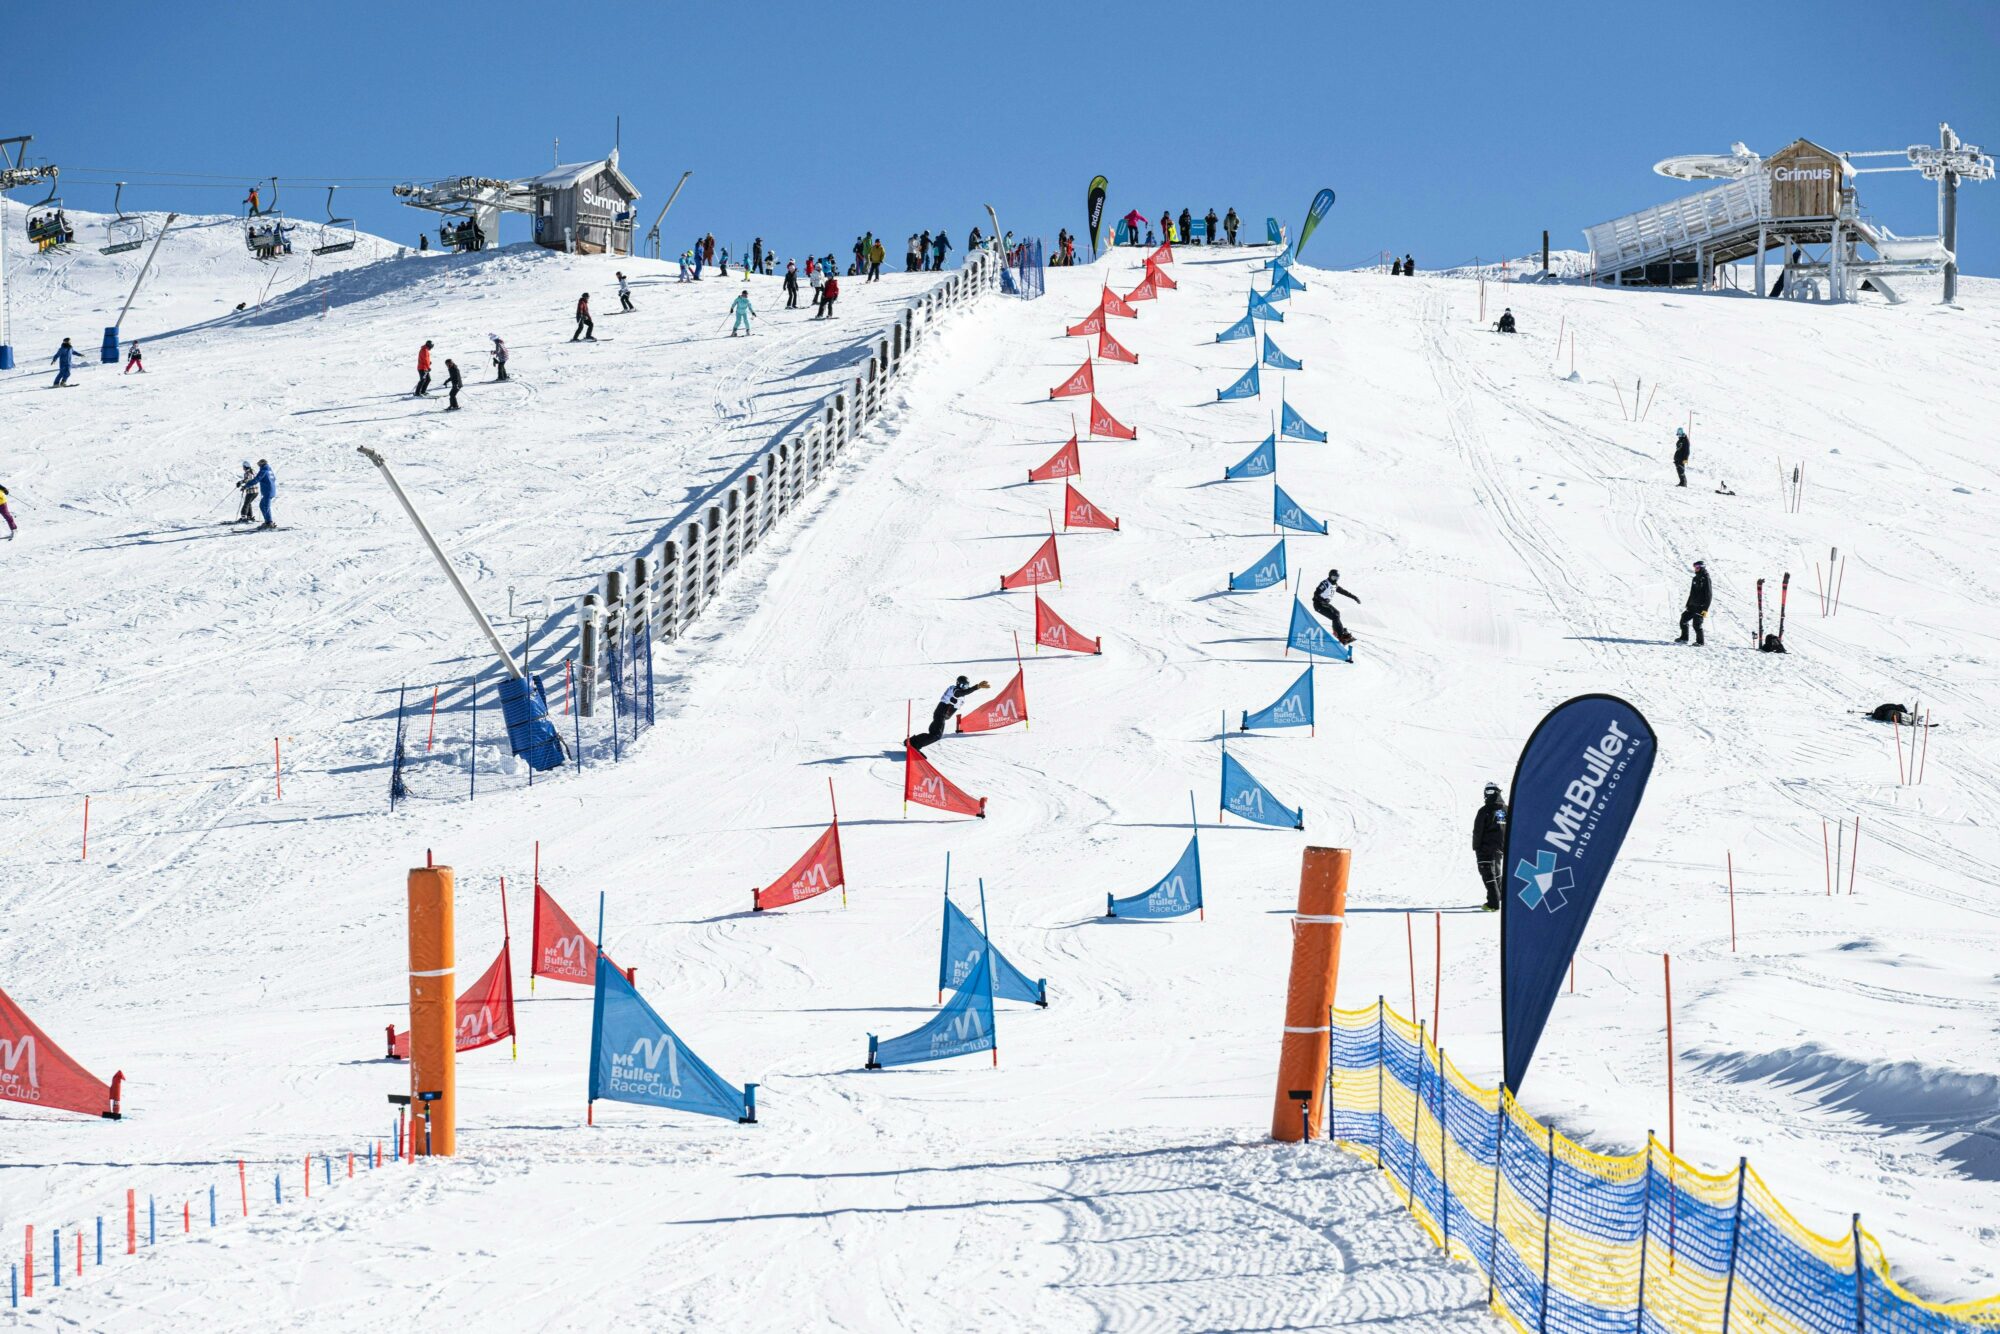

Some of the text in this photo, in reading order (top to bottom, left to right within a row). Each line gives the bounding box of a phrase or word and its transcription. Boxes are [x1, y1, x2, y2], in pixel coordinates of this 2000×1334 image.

[1775, 166, 1831, 181] Grimus
[583, 188, 626, 213] Summit
[1574, 738, 1641, 859] mtbuller.com.au
[1149, 897, 1177, 906] Buller
[544, 947, 558, 957] Mt
[544, 955, 574, 967] Buller
[954, 959, 969, 970] Mt
[612, 1053, 634, 1066] Mt
[611, 1065, 661, 1084] Buller
